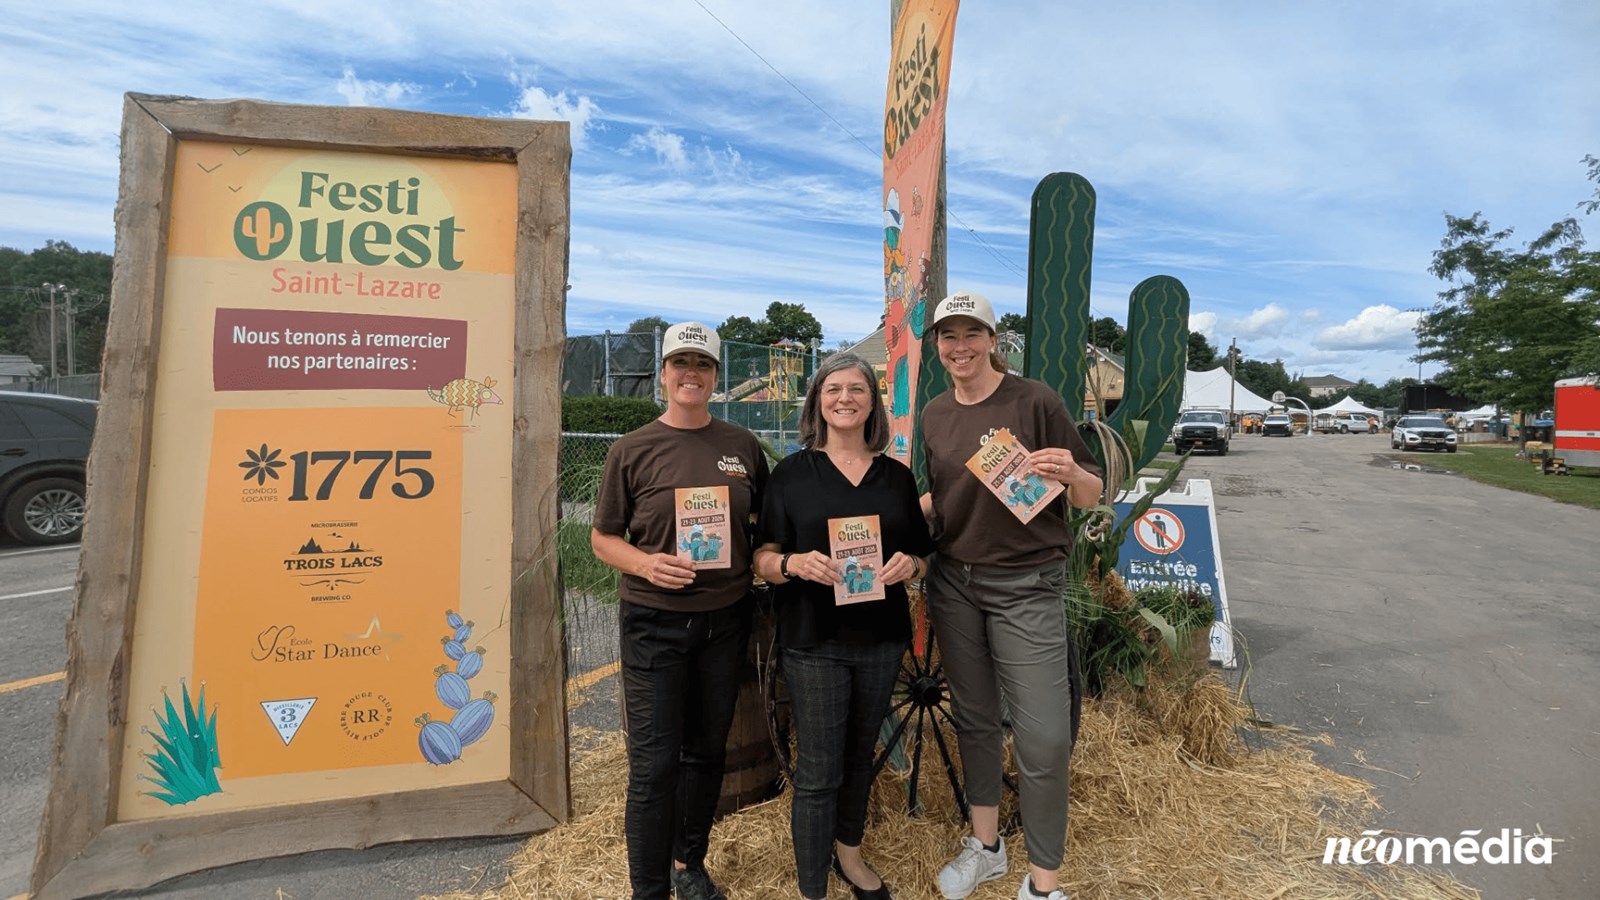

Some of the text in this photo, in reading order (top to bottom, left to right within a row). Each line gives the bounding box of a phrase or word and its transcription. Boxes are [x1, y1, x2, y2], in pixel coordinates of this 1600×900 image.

[895, 22, 927, 102] Festi
[885, 45, 941, 160] Ouest
[298, 171, 420, 216] Festi
[233, 201, 465, 271] Ouest
[271, 267, 442, 300] Saint-Lazare
[946, 301, 975, 310] Ouest
[233, 325, 450, 349] Nous tenons à remercier
[678, 331, 708, 343] Ouest
[268, 355, 300, 369] nos
[304, 353, 409, 375] partenaires
[981, 445, 1012, 473] Ouest
[982, 444, 999, 462] Festi
[717, 460, 747, 474] Ouest
[288, 450, 435, 501] 1775
[242, 487, 278, 495] CONDOS
[242, 495, 278, 503] LOCATIFS
[692, 492, 711, 501] Festi
[684, 499, 718, 510] Ouest
[845, 522, 863, 532] Festi
[838, 529, 870, 542] Ouest
[284, 556, 383, 571] TROIS LACS
[275, 643, 382, 663] Star Dance
[281, 708, 296, 722] 3
